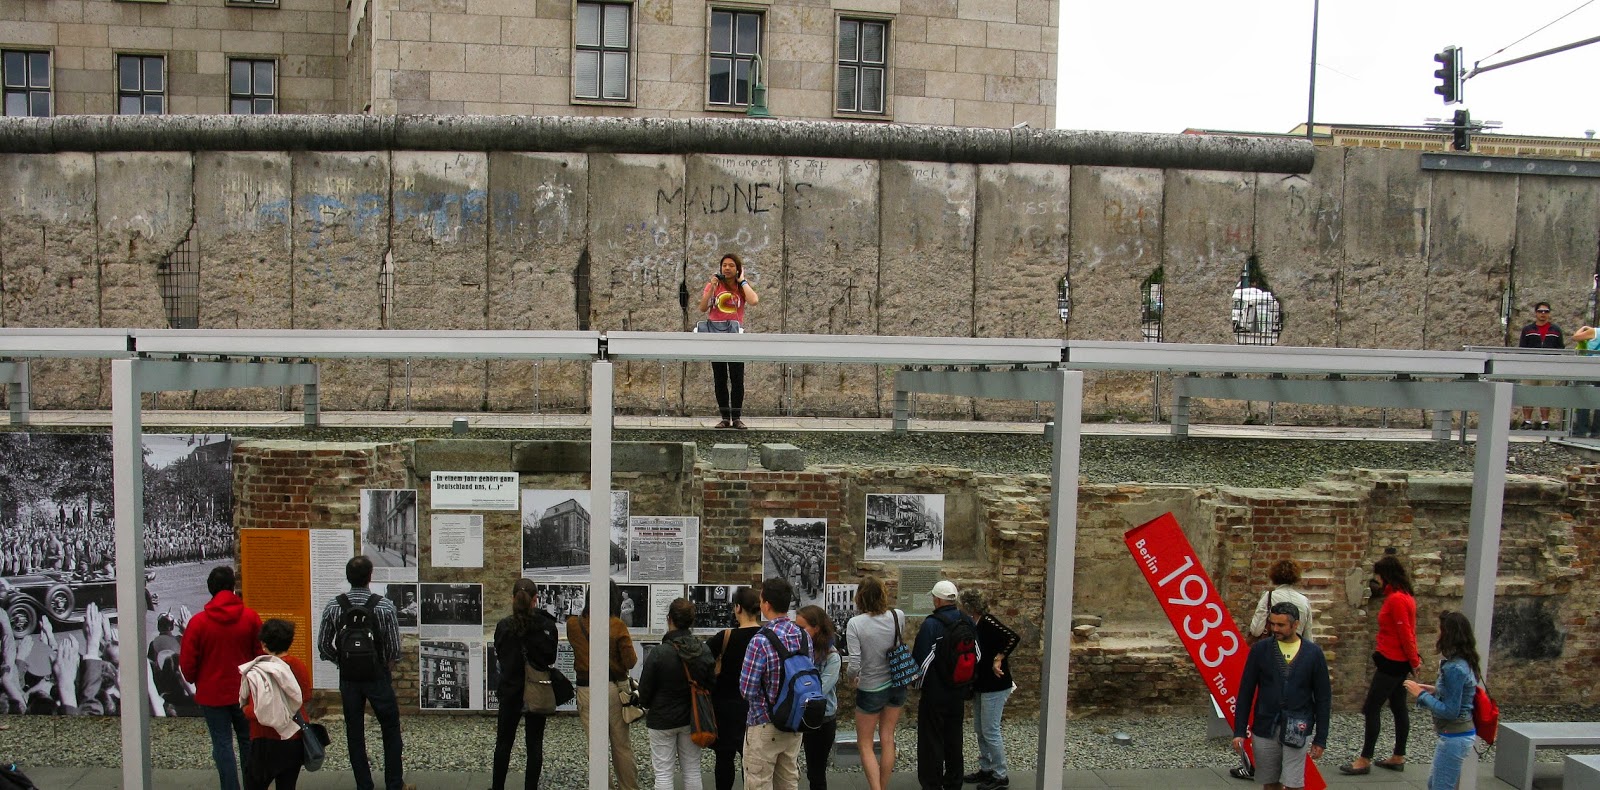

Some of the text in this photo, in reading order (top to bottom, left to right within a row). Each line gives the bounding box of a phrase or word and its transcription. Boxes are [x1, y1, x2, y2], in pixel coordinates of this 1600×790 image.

[656, 181, 813, 217] MADNESS
[478, 475, 499, 483] gehört
[1135, 538, 1158, 574] Berlin
[1158, 555, 1239, 668] 1933
[1213, 672, 1228, 695] The
[1225, 696, 1236, 716] Pa
